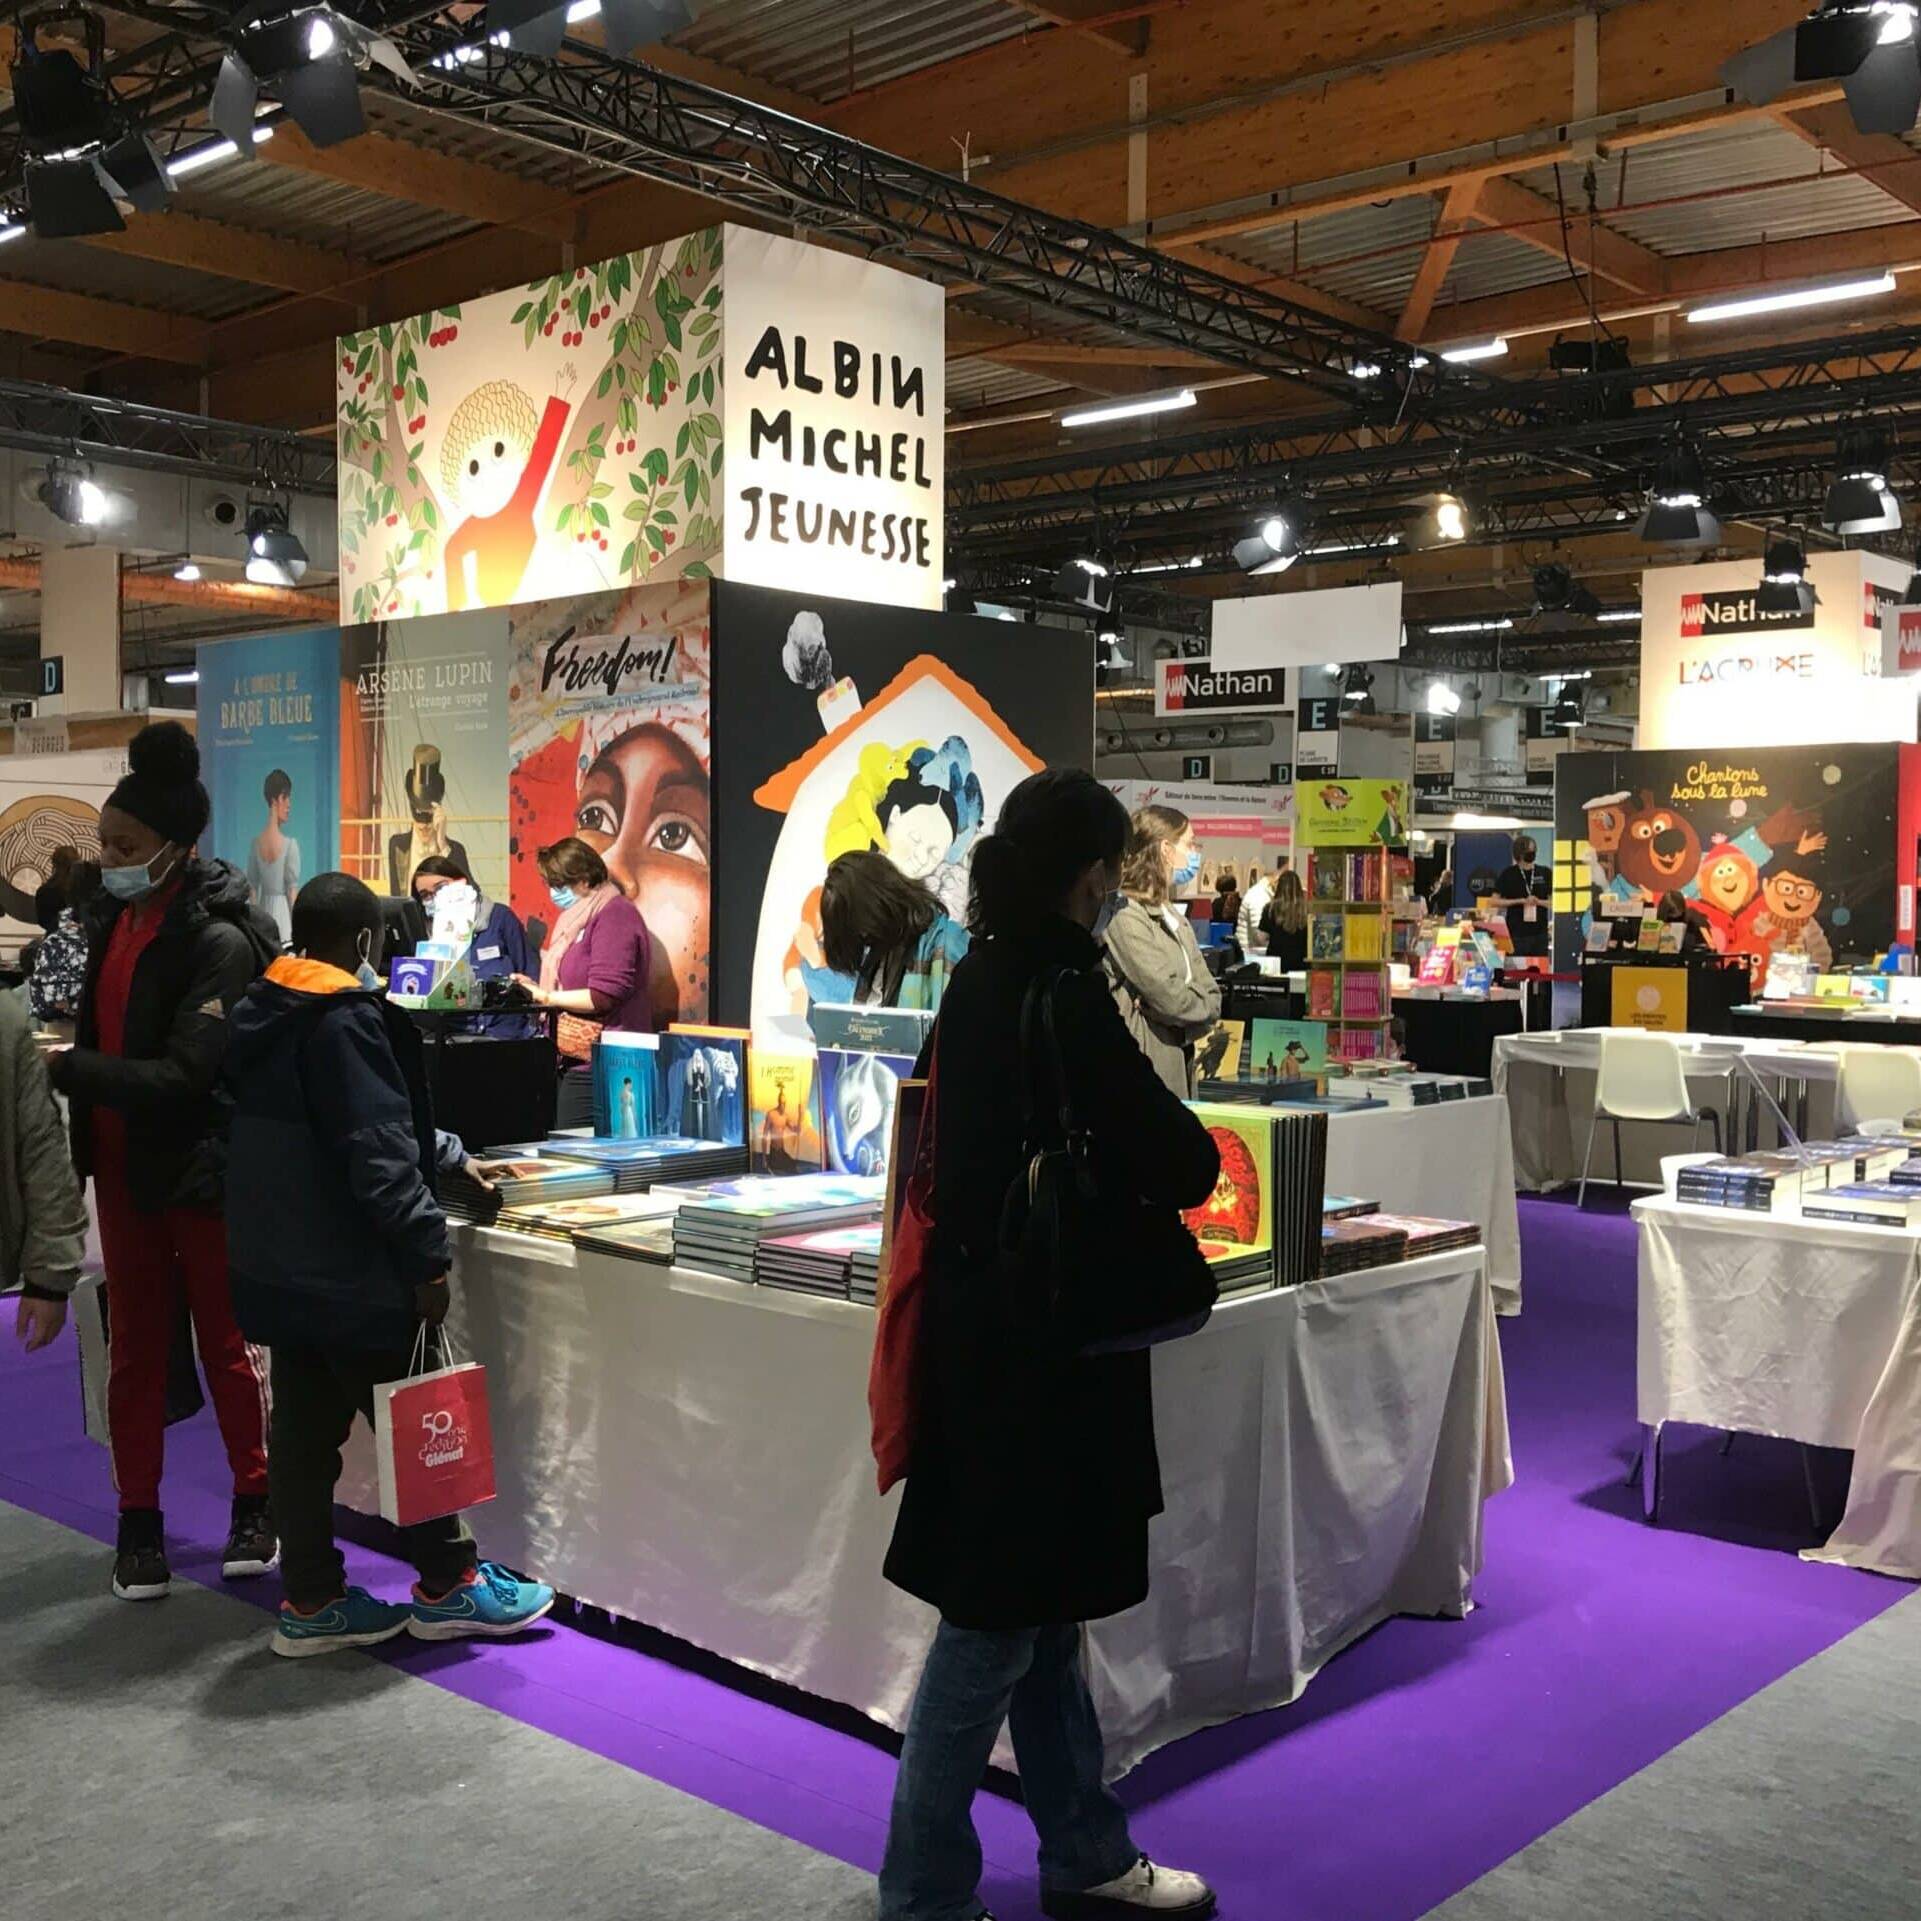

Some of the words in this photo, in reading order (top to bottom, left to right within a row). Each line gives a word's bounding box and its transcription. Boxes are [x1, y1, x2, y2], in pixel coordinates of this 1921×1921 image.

[745, 326, 924, 417] ALBIN
[750, 408, 931, 488] MICHEL
[740, 487, 930, 567] JEUNESSE
[541, 625, 677, 696] Freedom!
[45, 662, 56, 692] D
[355, 665, 425, 695] ARSÈNE
[435, 661, 493, 688] LUPIN
[1183, 671, 1272, 697] Nathan
[221, 698, 263, 734] BARBE
[269, 694, 312, 725] BLEUE
[1312, 702, 1327, 728] E
[1428, 714, 1442, 740] E
[1541, 710, 1556, 736] E
[1191, 760, 1202, 778] D
[1278, 766, 1289, 784] D
[1687, 761, 1759, 785] Chantons
[1671, 783, 1706, 800] sous
[1709, 783, 1728, 799] la
[1731, 782, 1768, 798] lune
[422, 1410, 453, 1443] 50
